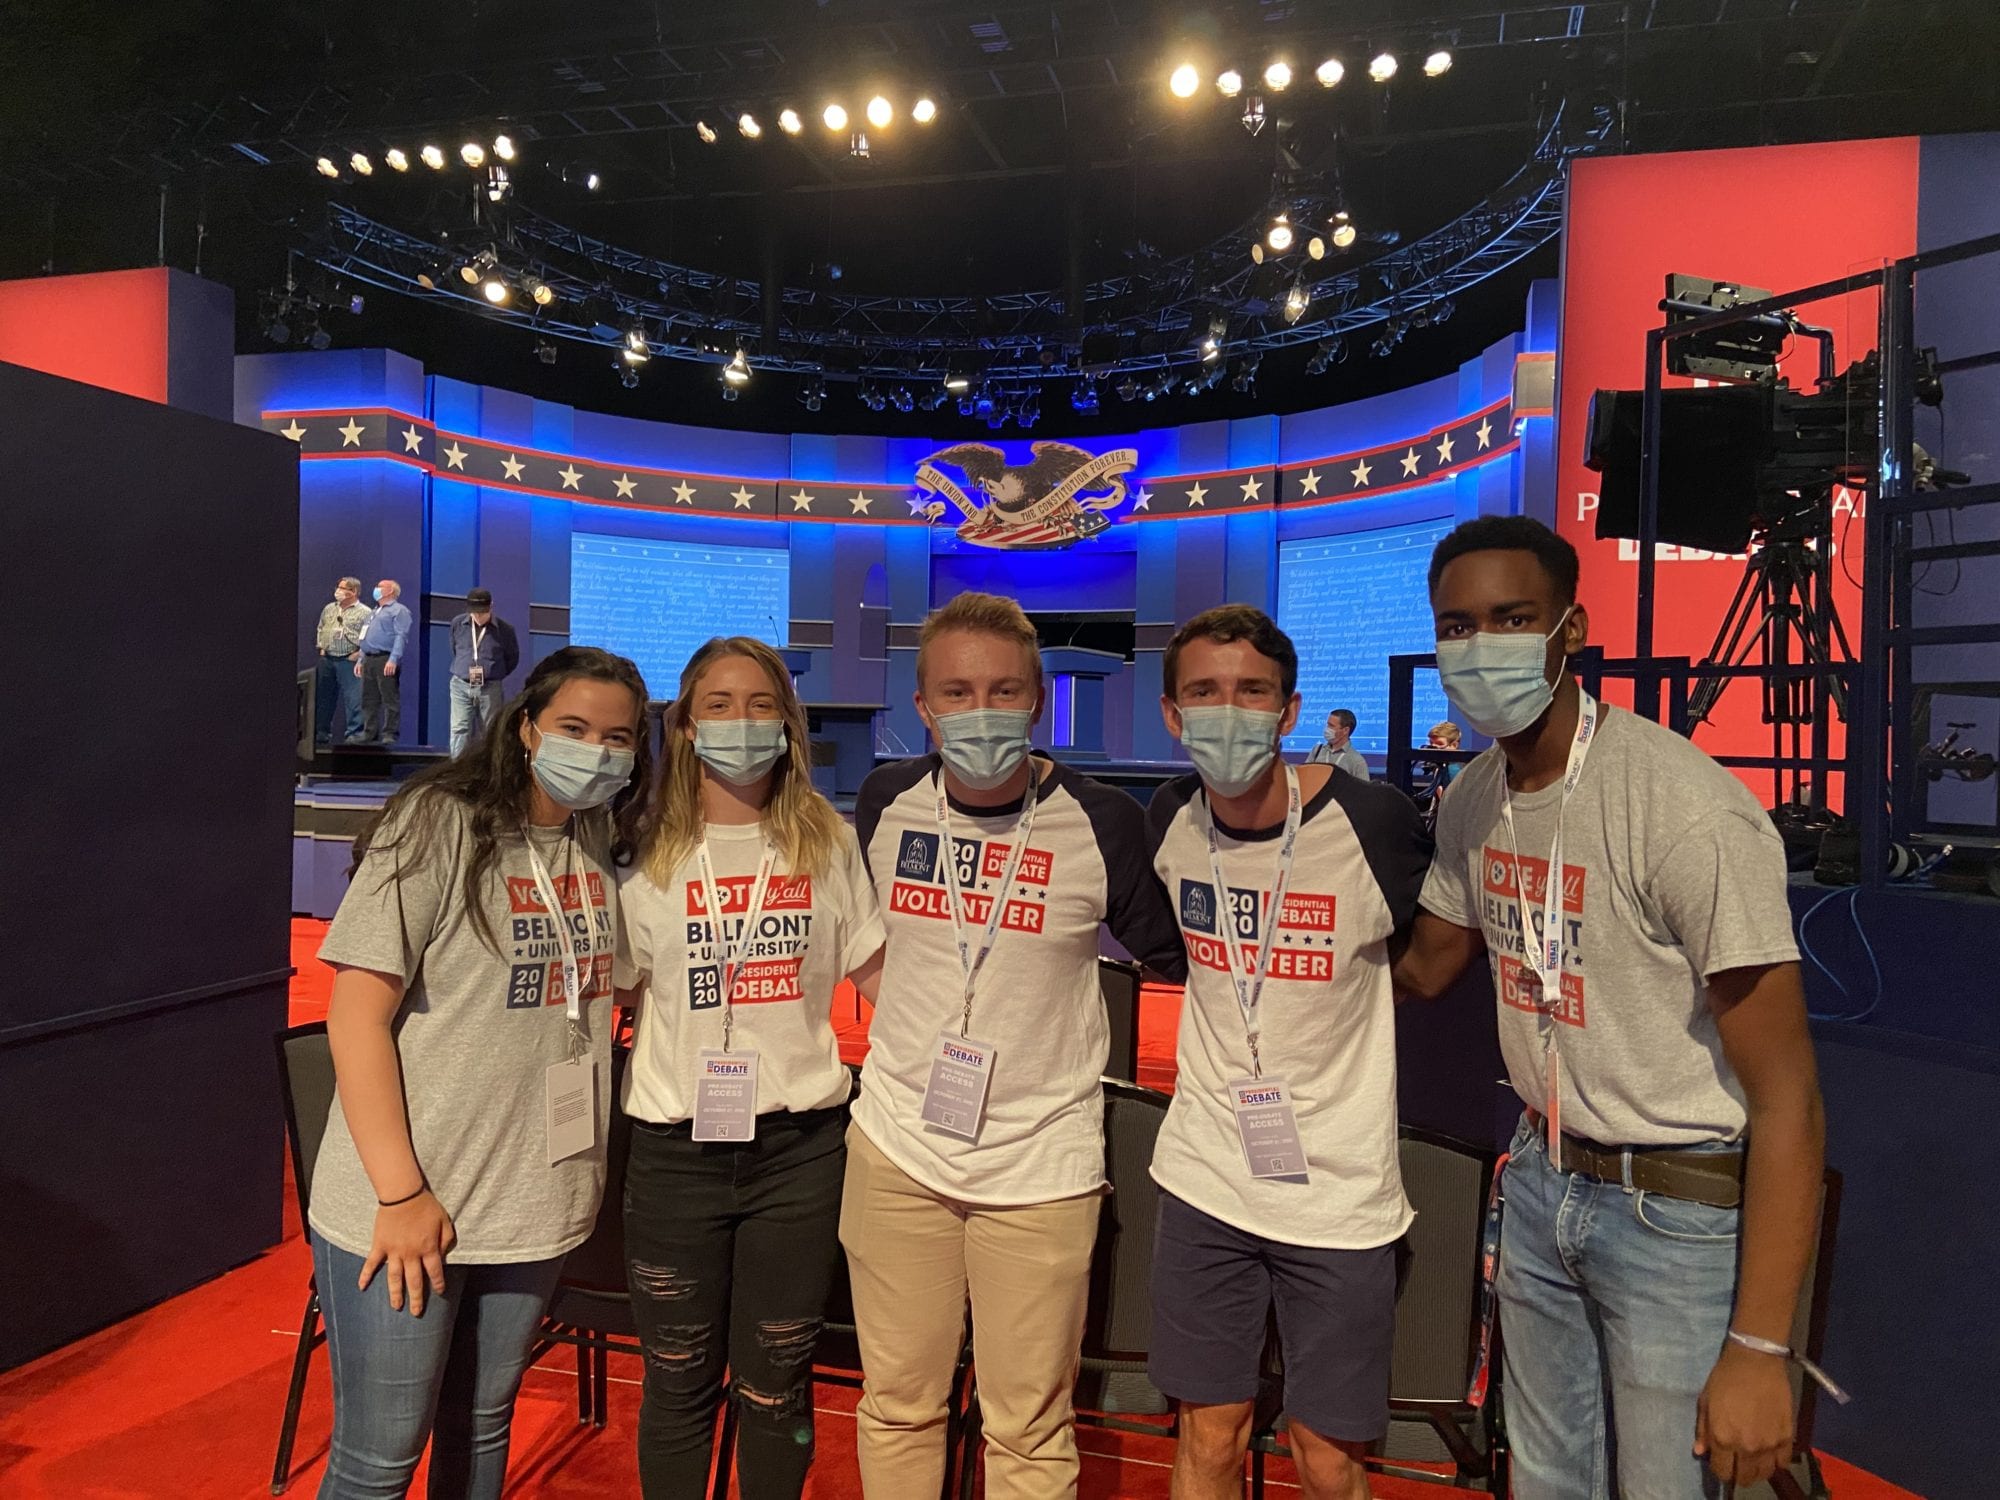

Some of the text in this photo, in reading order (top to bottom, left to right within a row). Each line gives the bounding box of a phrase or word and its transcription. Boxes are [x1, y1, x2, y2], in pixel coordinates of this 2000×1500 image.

[926, 470, 978, 519] THE UNION AND
[1021, 510, 1037, 522] THE
[1037, 470, 1090, 515] CONSTITUTION
[990, 848, 1048, 866] PRENTIAL
[987, 858, 1046, 880] DEATE
[691, 881, 808, 909] VOT y'all
[1281, 898, 1330, 910] SIDENTIAL
[896, 887, 1040, 929] VOLUNTER
[1280, 908, 1330, 926] EBATE
[1484, 894, 1582, 948] ELMOT
[701, 940, 802, 961] UIRSITY
[1186, 936, 1328, 977] VOLNTEER
[515, 969, 540, 986] 20
[693, 970, 716, 988] 20
[513, 987, 538, 1004] 20
[694, 988, 718, 1005] 20
[732, 977, 799, 1000] DEBAT
[1505, 978, 1580, 1020] DEBTE
[949, 1048, 983, 1066] DEBATE
[714, 1065, 748, 1074] DEBATE
[1247, 1092, 1282, 1104] DEBATE
